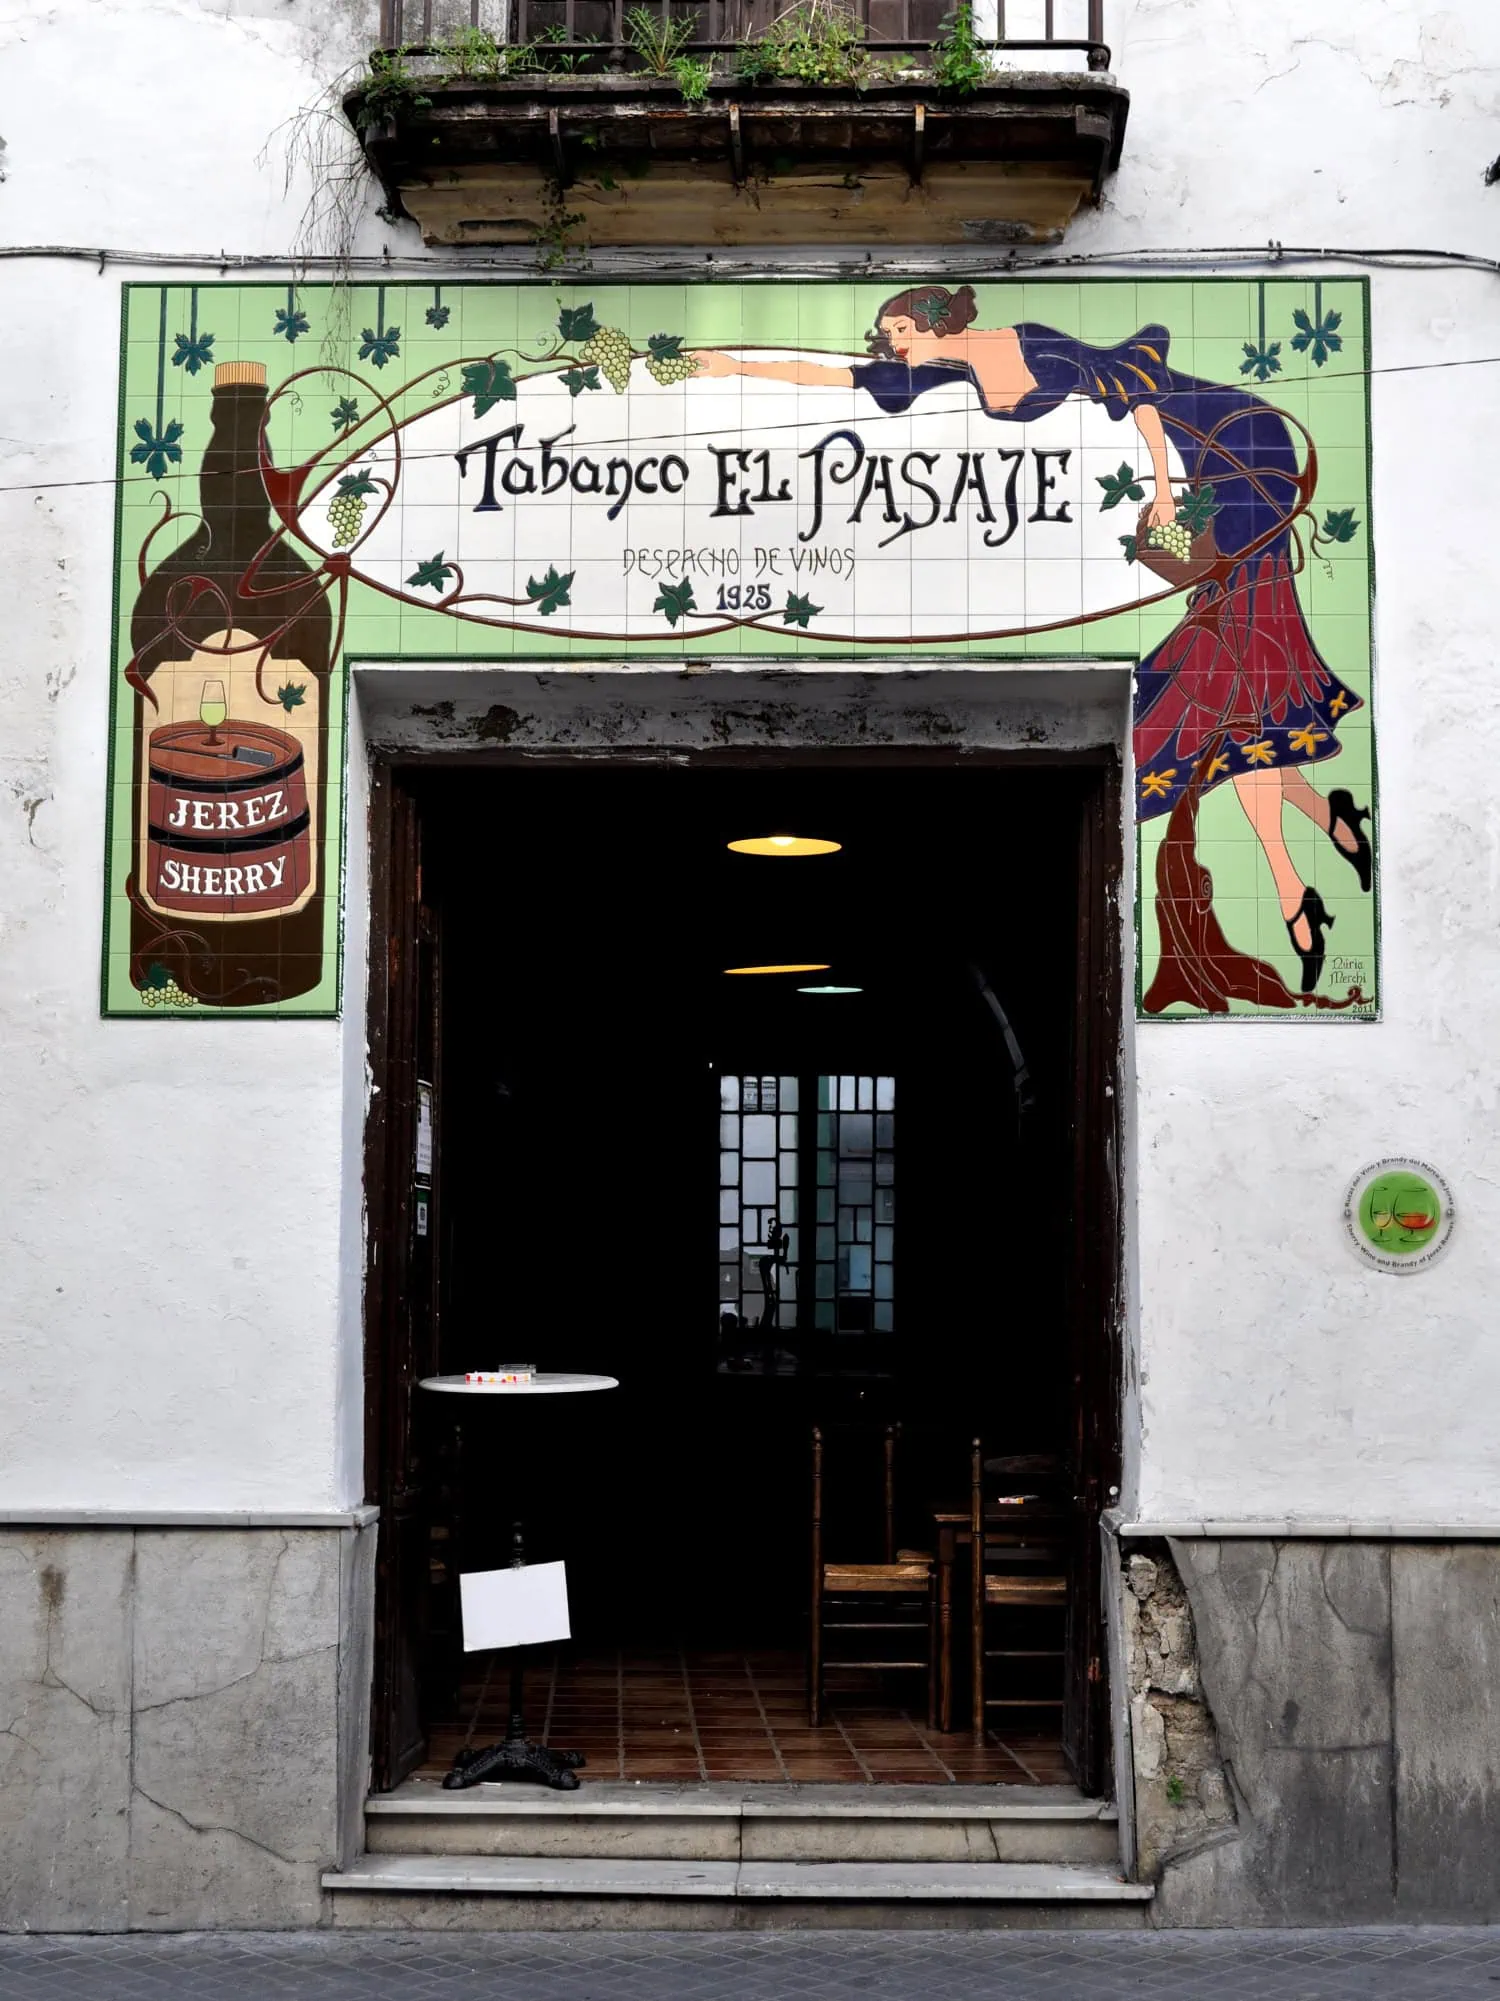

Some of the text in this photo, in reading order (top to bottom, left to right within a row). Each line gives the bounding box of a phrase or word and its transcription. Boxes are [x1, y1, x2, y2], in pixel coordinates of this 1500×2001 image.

[454, 423, 690, 519] Tabanco
[797, 427, 1074, 548] PASAJE
[623, 546, 856, 581] DESPACHO DE VINOS
[716, 583, 772, 610] 1925
[169, 790, 288, 831] JEREZ
[160, 856, 287, 897] SHERRY
